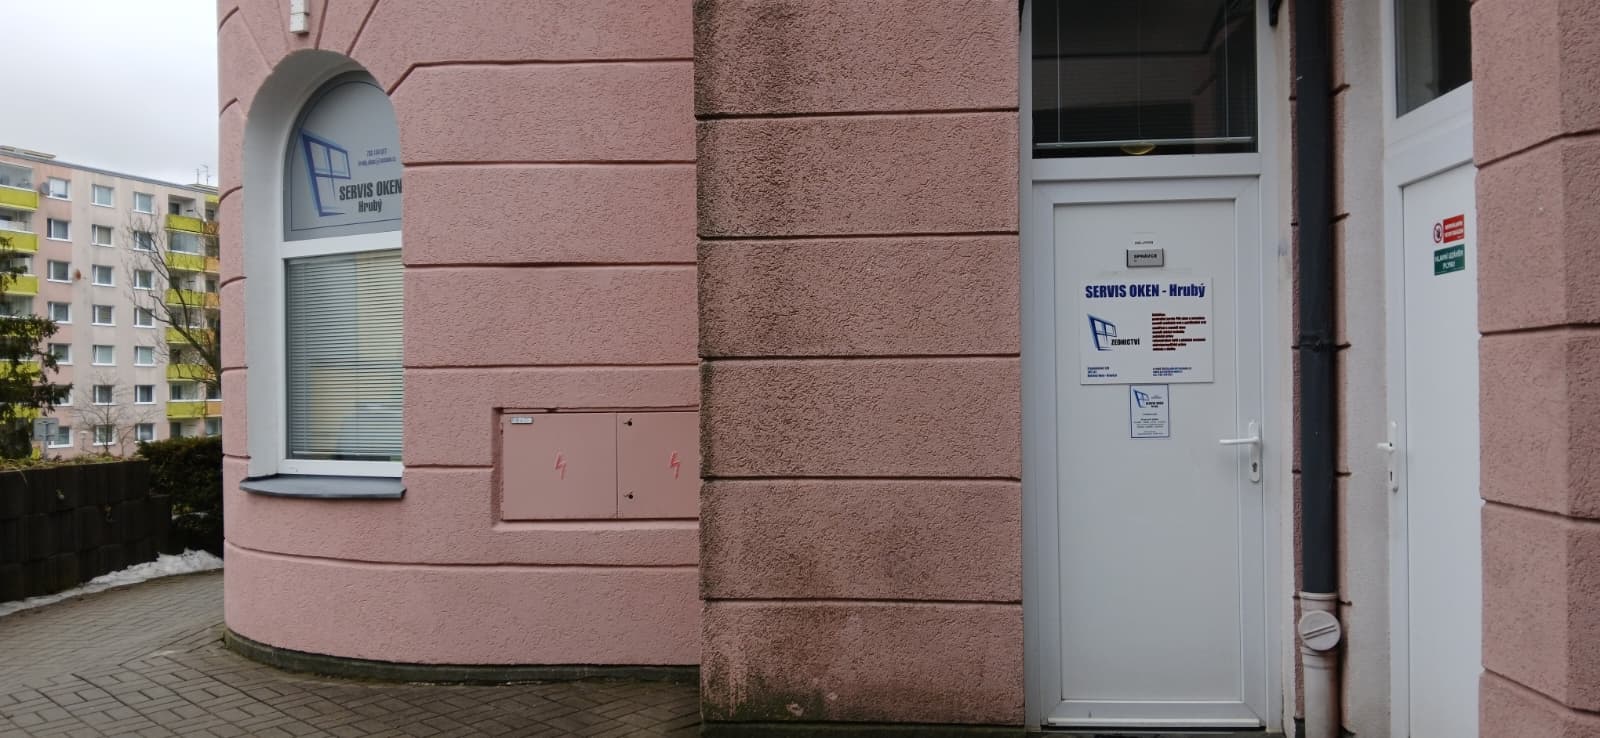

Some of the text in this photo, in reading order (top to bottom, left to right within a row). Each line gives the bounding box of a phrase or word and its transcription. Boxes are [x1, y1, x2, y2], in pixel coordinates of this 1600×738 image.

[339, 179, 402, 201] SERVIS OKEN
[358, 198, 382, 213] Hrubý
[1085, 284, 1127, 299] SERVIS
[1129, 283, 1160, 298] OKEN
[1169, 282, 1206, 298] Hrubý
[1111, 337, 1141, 346] ZEDNICTVÍ
